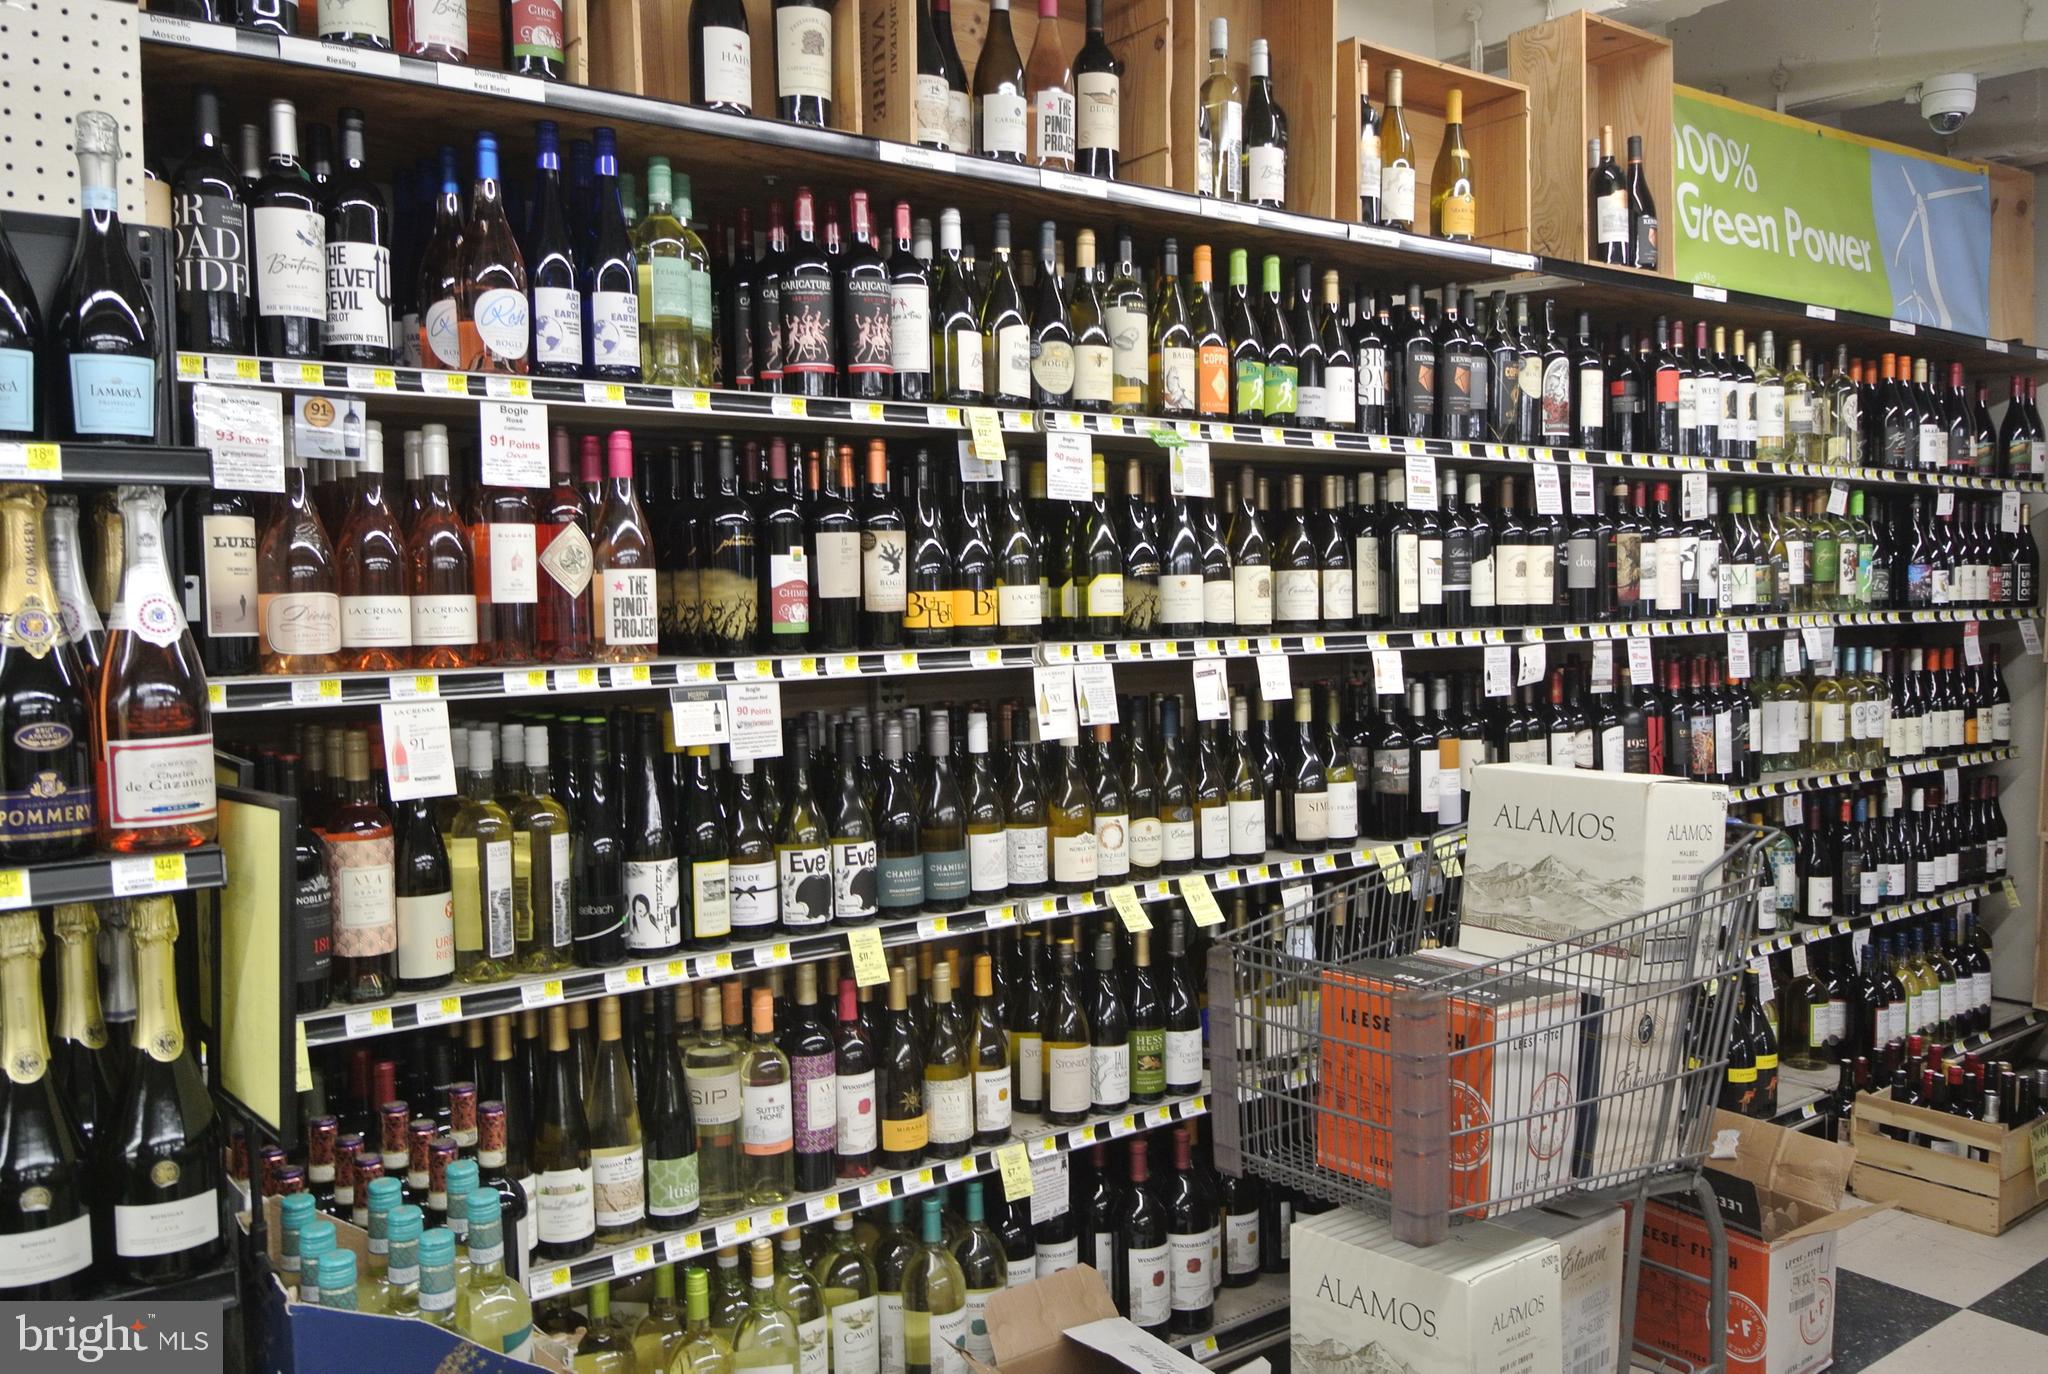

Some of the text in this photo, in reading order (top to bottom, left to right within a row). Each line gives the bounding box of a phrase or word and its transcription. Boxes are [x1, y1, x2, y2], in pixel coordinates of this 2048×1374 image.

[150, 15, 191, 28] Domestic
[152, 29, 191, 42] Moscato
[326, 56, 356, 69] Riesling
[872, 11, 887, 123] VAURE
[474, 82, 510, 95] Red Blend
[1058, 97, 1071, 110] THE
[1045, 115, 1071, 134] PINOT
[1673, 121, 1758, 193] 100%
[1677, 182, 1872, 272] Green Power
[781, 280, 831, 291] CARICATURE
[849, 280, 891, 291] CARICATU
[566, 292, 579, 302] ART
[622, 296, 636, 306] ART
[554, 309, 579, 320] EARTH
[611, 313, 636, 324] EARTH
[310, 403, 328, 417] 91
[500, 405, 529, 416] Bogle
[216, 429, 235, 441] 93
[490, 434, 541, 451] 91 Points
[26, 520, 36, 585] POMMERY
[629, 576, 648, 596] THE
[348, 607, 403, 615] LA CREMA
[417, 607, 469, 615] LA CREMA
[613, 597, 648, 616] PINOT
[614, 618, 657, 639] PROJECT
[737, 706, 773, 716] 90 Points
[409, 738, 426, 752] 91
[156, 769, 195, 780] Charles
[125, 775, 215, 793] de Cazanove
[0, 803, 92, 828] POMMERY
[1494, 803, 1614, 842] ALAMOS
[1666, 824, 1713, 842] ALAMOS
[844, 845, 875, 866] Eve
[789, 852, 826, 874] Eve
[729, 873, 760, 884] CHLOE
[296, 894, 320, 906] NOBLE
[578, 903, 615, 915] selbach
[1137, 1033, 1163, 1046] HESS
[1137, 1043, 1163, 1052] SELECT
[691, 1089, 728, 1105] SIP
[756, 1104, 785, 1115] SUTTER
[759, 1112, 784, 1122] HOME
[1561, 1245, 1608, 1280] Estancia
[1316, 1274, 1439, 1341] ALAMOS
[1491, 1294, 1545, 1335] ALAMOS
[1506, 1326, 1531, 1345] MALBEC
